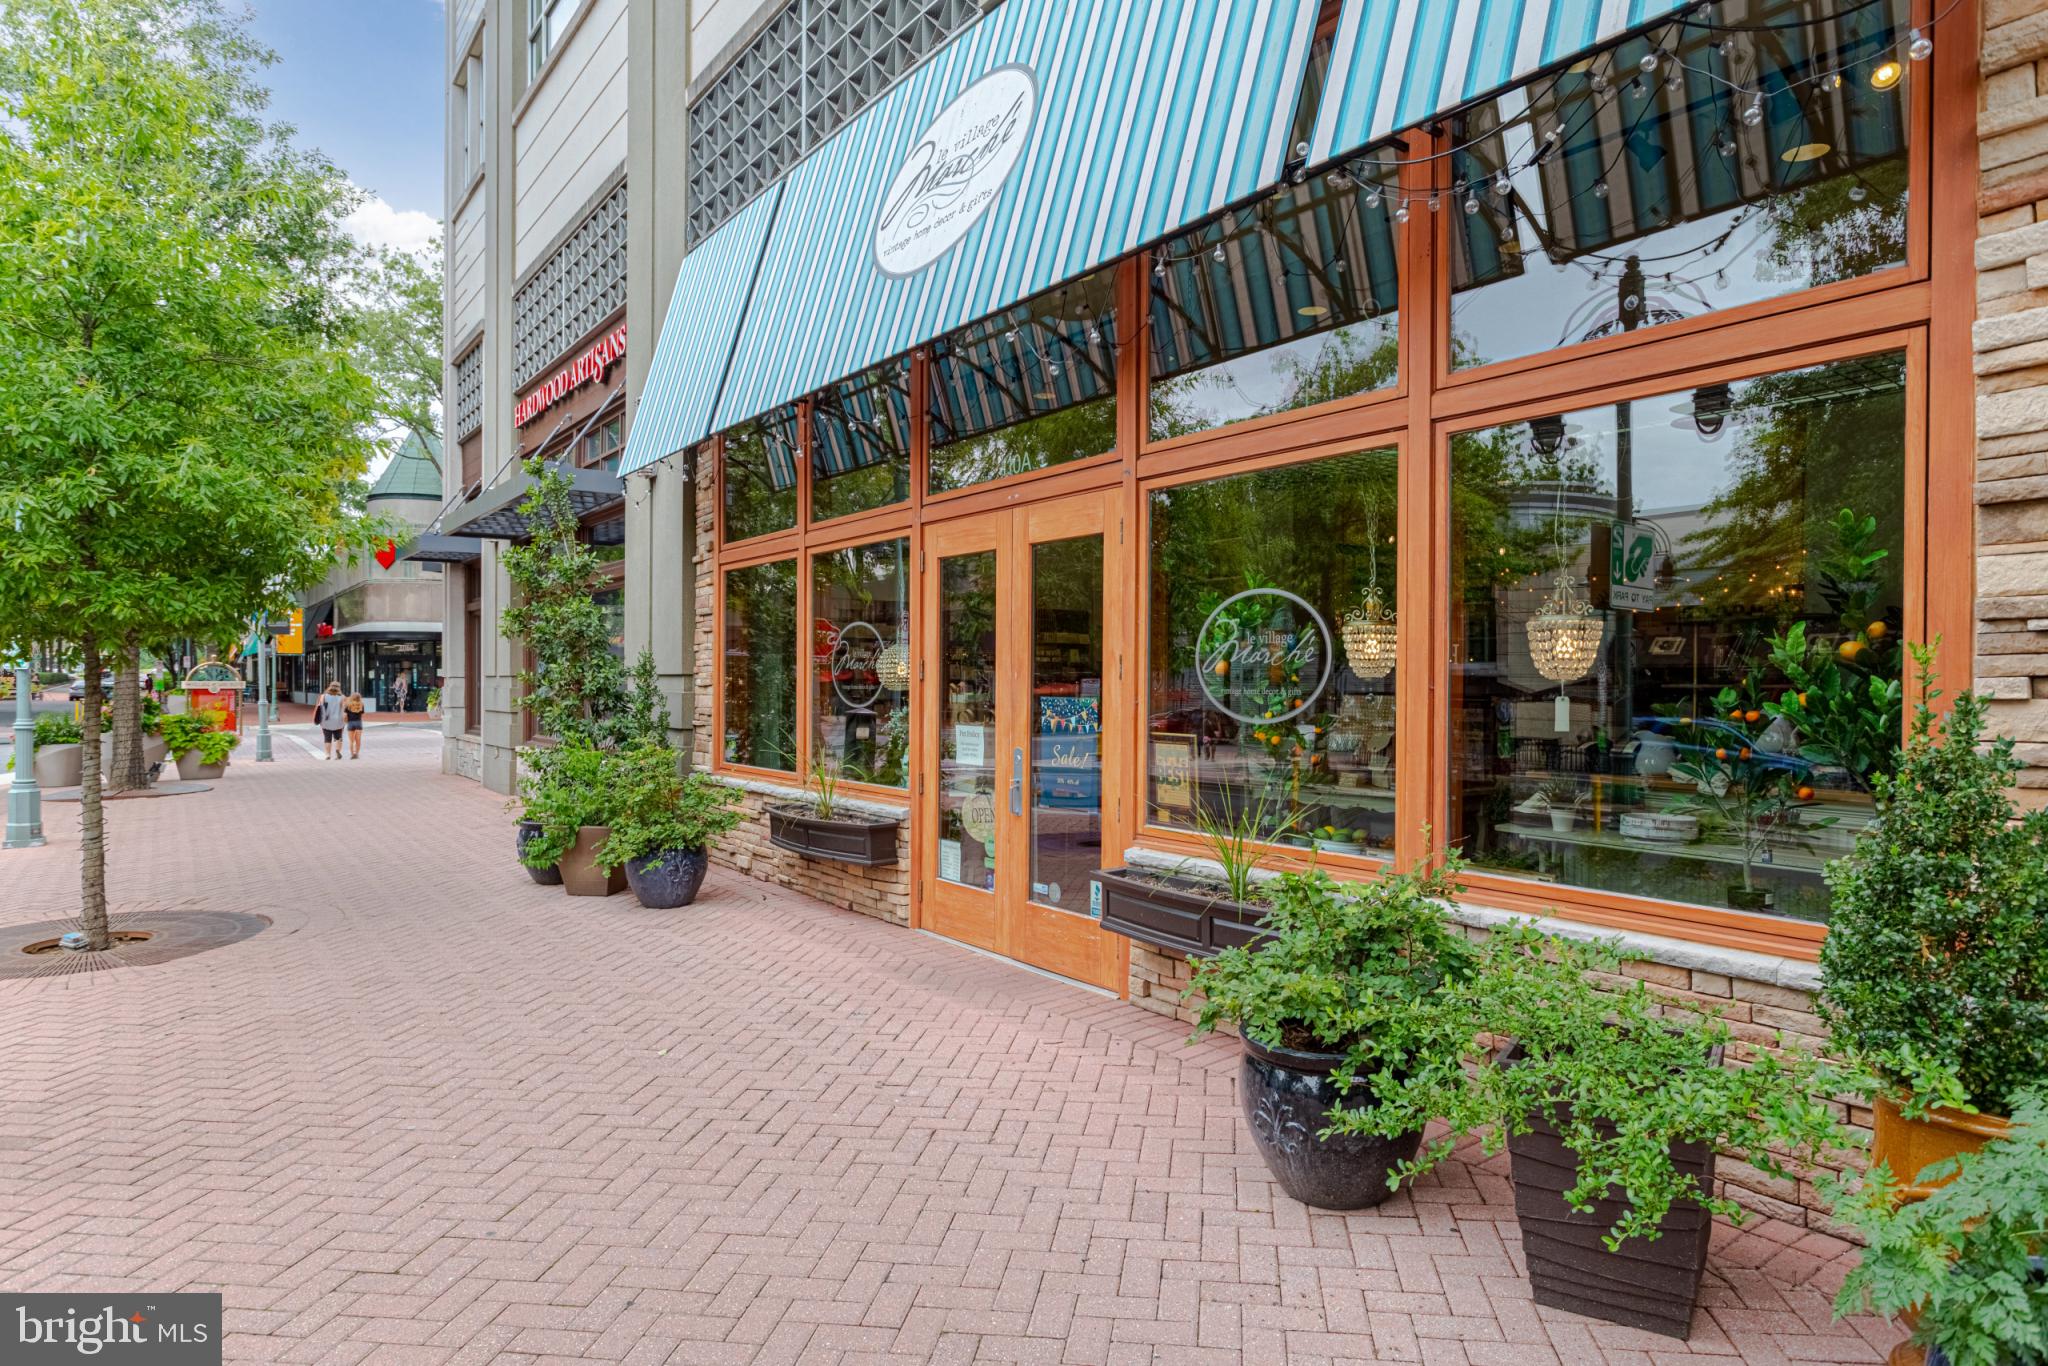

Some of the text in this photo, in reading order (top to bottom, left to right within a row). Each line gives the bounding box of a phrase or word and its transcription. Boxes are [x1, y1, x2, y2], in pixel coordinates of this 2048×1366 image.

[937, 114, 1000, 163] le village
[966, 188, 993, 213] gifts
[514, 324, 627, 428] HARDWOOD ARTISANS
[1202, 619, 1315, 673] Marché
[1247, 631, 1293, 647] le village
[1051, 744, 1088, 769] Sale!
[971, 807, 996, 824] OPEN
